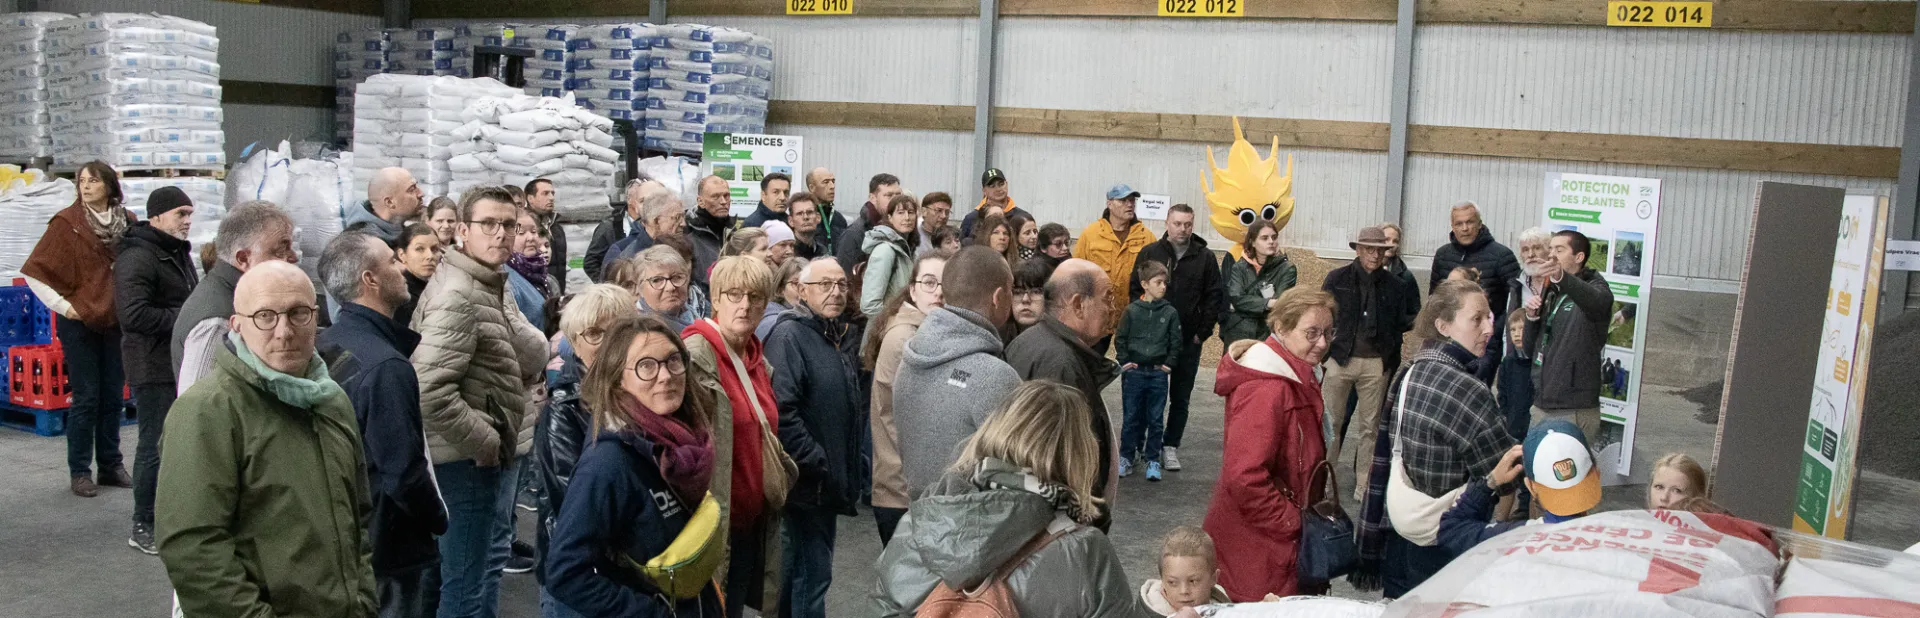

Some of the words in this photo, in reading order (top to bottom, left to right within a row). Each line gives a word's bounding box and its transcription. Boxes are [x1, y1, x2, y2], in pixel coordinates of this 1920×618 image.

[791, 0, 816, 12] 022
[822, 0, 848, 12] 010
[1166, 0, 1196, 13] 022
[1206, 0, 1236, 13] 012
[1617, 5, 1654, 22] 022
[1665, 6, 1703, 23] 014
[723, 135, 783, 147] SEMENCES
[987, 169, 997, 178] H
[1553, 179, 1630, 195] PROTECTION
[1561, 194, 1579, 204] DES
[1582, 197, 1625, 208] PLANTES
